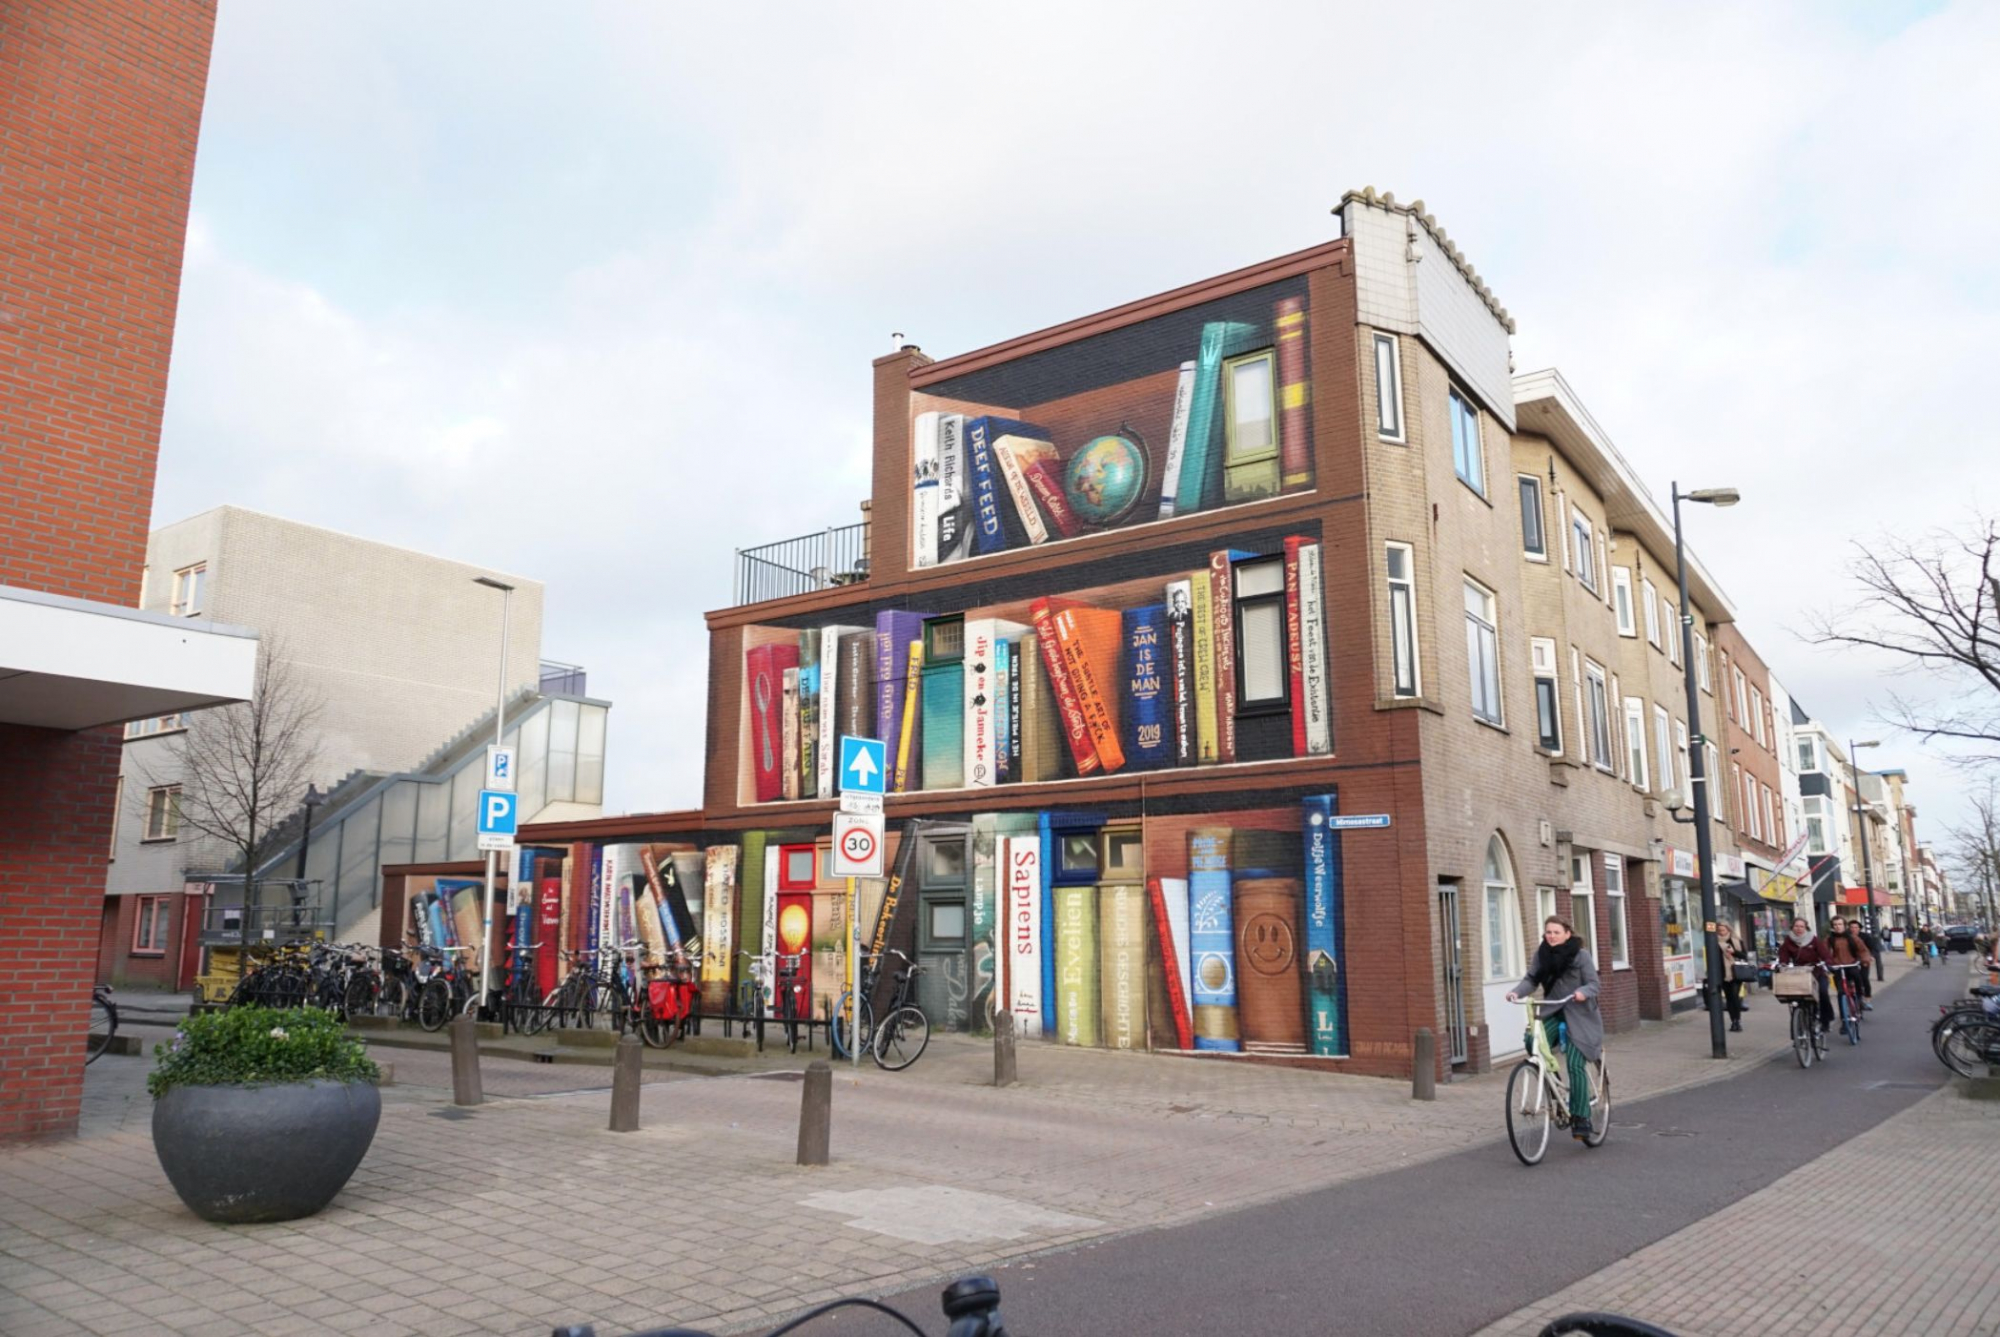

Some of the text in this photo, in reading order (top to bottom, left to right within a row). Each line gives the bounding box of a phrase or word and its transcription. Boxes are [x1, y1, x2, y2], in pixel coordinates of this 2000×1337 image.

[944, 420, 956, 501] Keith Richards
[971, 426, 998, 535] DEEF FEED
[943, 516, 955, 541] Life
[1287, 561, 1302, 673] PAN TADEUSZ
[976, 635, 988, 658] Jip
[1133, 633, 1158, 647] JAN
[1306, 617, 1319, 651] Feest
[1136, 662, 1155, 677] DE
[1139, 648, 1152, 661] IS
[908, 656, 920, 691] FRED
[977, 676, 986, 691] en
[1072, 668, 1088, 702] GIVING
[1131, 676, 1161, 691] MAN
[801, 677, 813, 771] DE GRUFFALO
[1011, 704, 1020, 736] MEISJE
[1093, 701, 1106, 717] ART
[976, 708, 988, 762] Janneke
[1011, 738, 1020, 757] HET
[1137, 723, 1161, 741] 2019
[497, 755, 506, 767] P
[819, 743, 829, 777] Sarah
[487, 796, 510, 829] P
[847, 838, 870, 851] 30
[889, 875, 902, 893] De
[1311, 832, 1326, 928] Dolfje Weerwolfje
[973, 877, 984, 925] Lampje
[1012, 851, 1036, 955] Sapiens
[718, 911, 727, 967] HOSSEINI
[1063, 892, 1083, 986] Evelien
[1116, 951, 1131, 1049] GESCHICHTE
[1317, 1011, 1333, 1031] L
